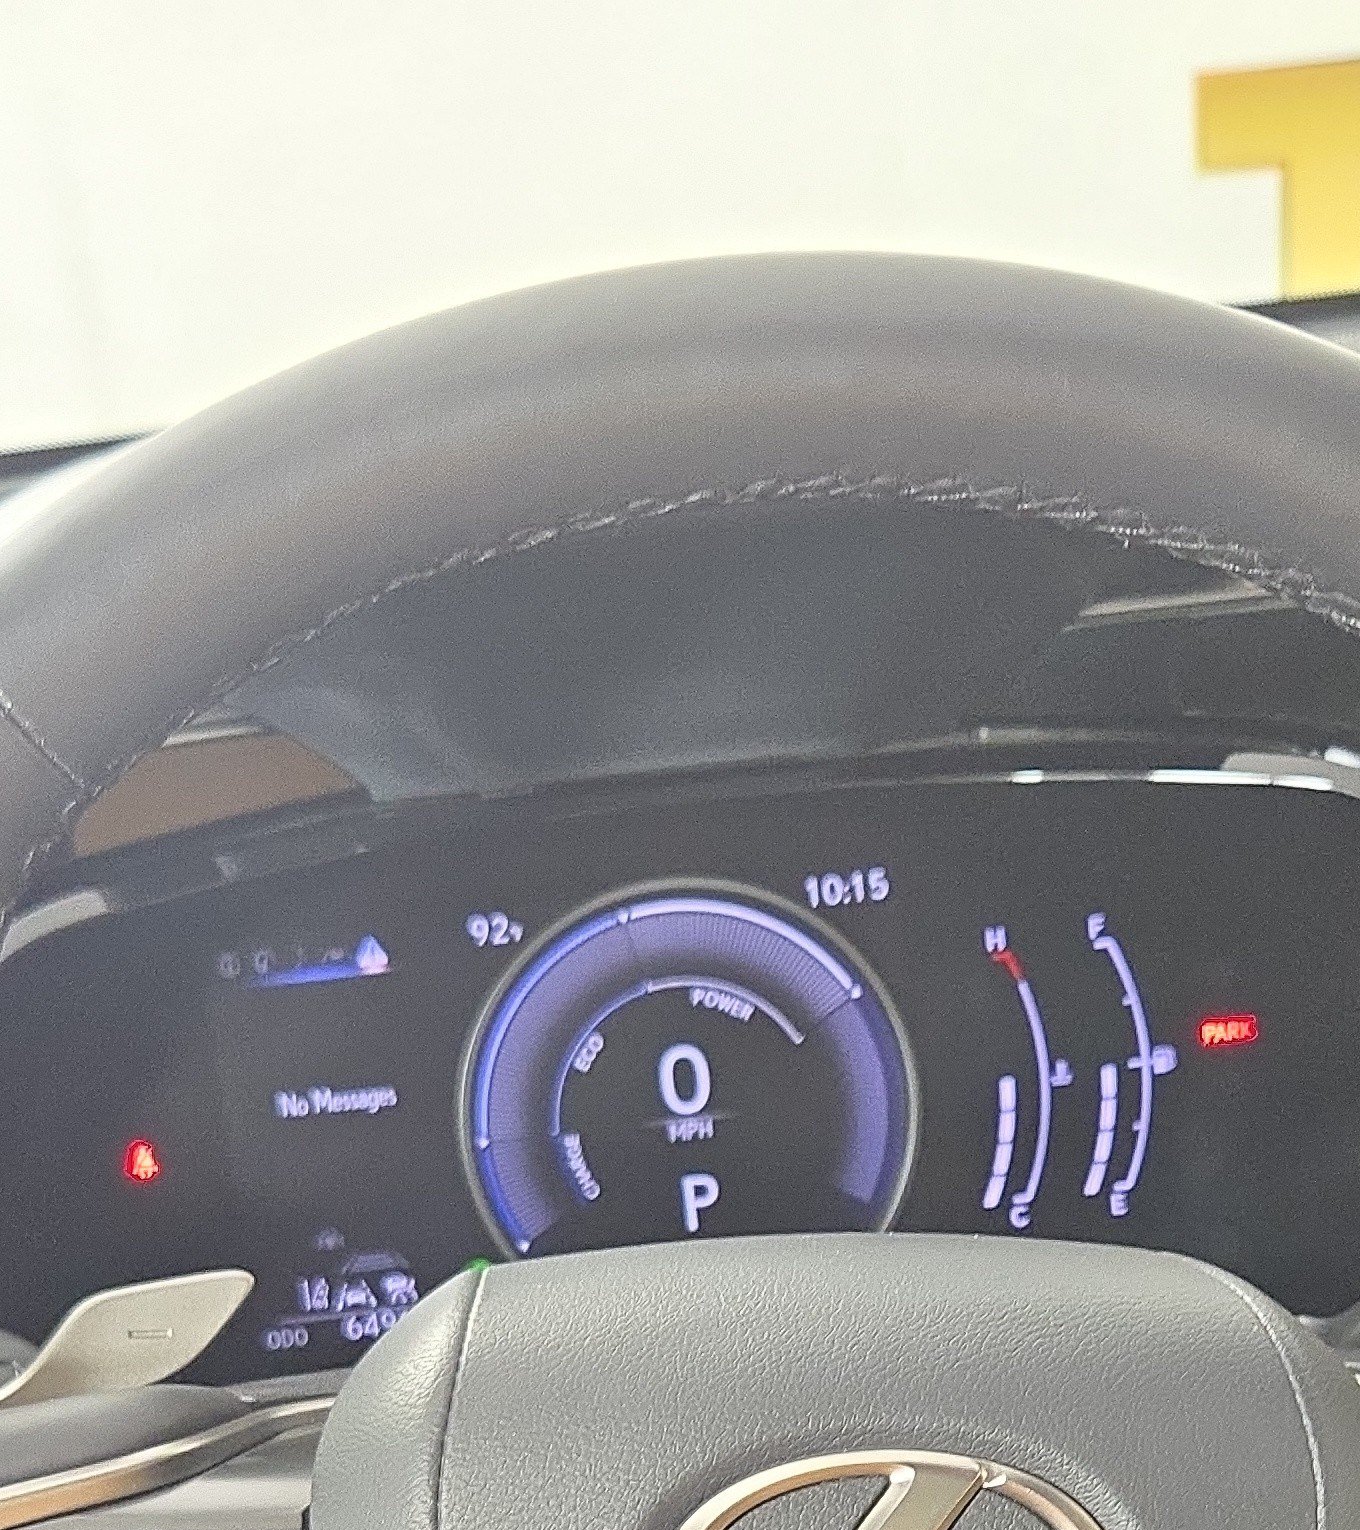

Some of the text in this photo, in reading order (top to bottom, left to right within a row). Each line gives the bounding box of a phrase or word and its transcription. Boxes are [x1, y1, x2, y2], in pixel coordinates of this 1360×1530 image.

[804, 866, 890, 909] 10:15
[692, 987, 755, 1022] POWER
[573, 1031, 604, 1073] ECO
[658, 1043, 711, 1116] 0
[274, 1085, 398, 1119] No Messages
[666, 1117, 715, 1143] MPH
[681, 1173, 720, 1232] P
[1009, 1205, 1031, 1228] C
